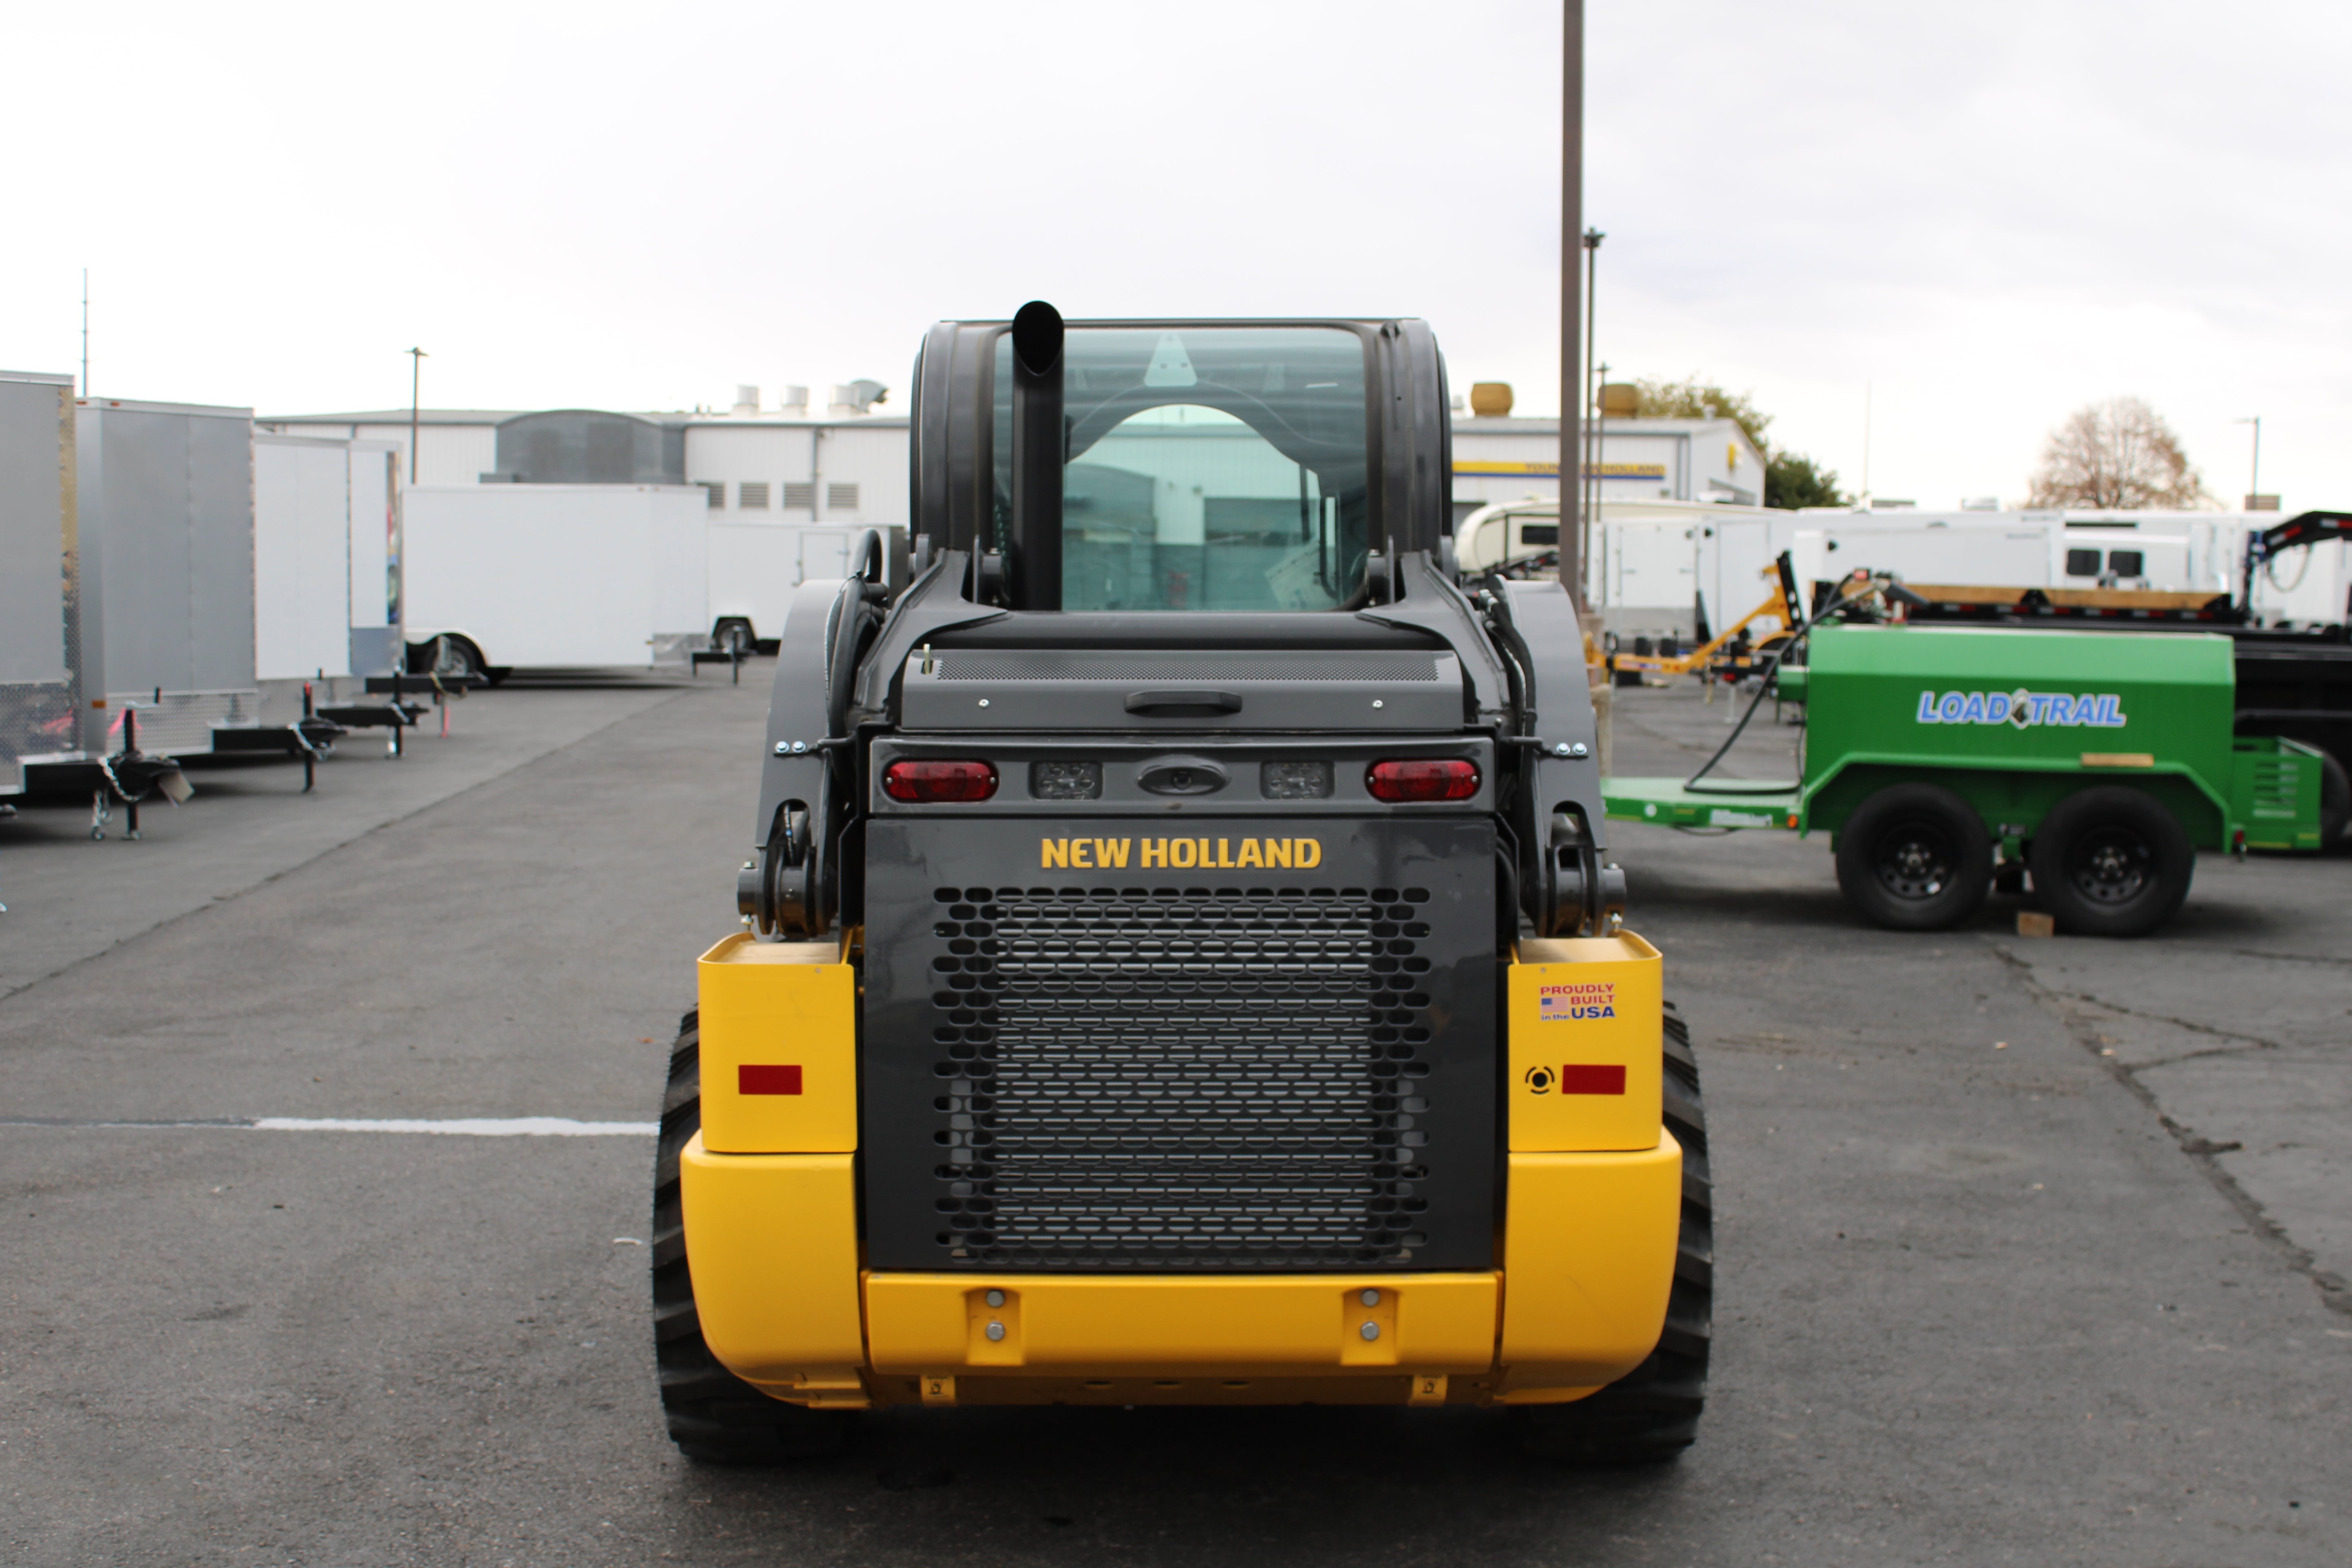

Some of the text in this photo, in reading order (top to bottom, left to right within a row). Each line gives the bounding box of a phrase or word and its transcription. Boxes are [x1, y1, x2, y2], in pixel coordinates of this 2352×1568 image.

[1916, 690, 2127, 728] LOAD TRAIL
[1041, 838, 1322, 868] NEW HOLLAND
[1541, 983, 1614, 995] PROUDLY
[1571, 995, 1615, 1004] BUILT
[1572, 1007, 1615, 1019] USA
